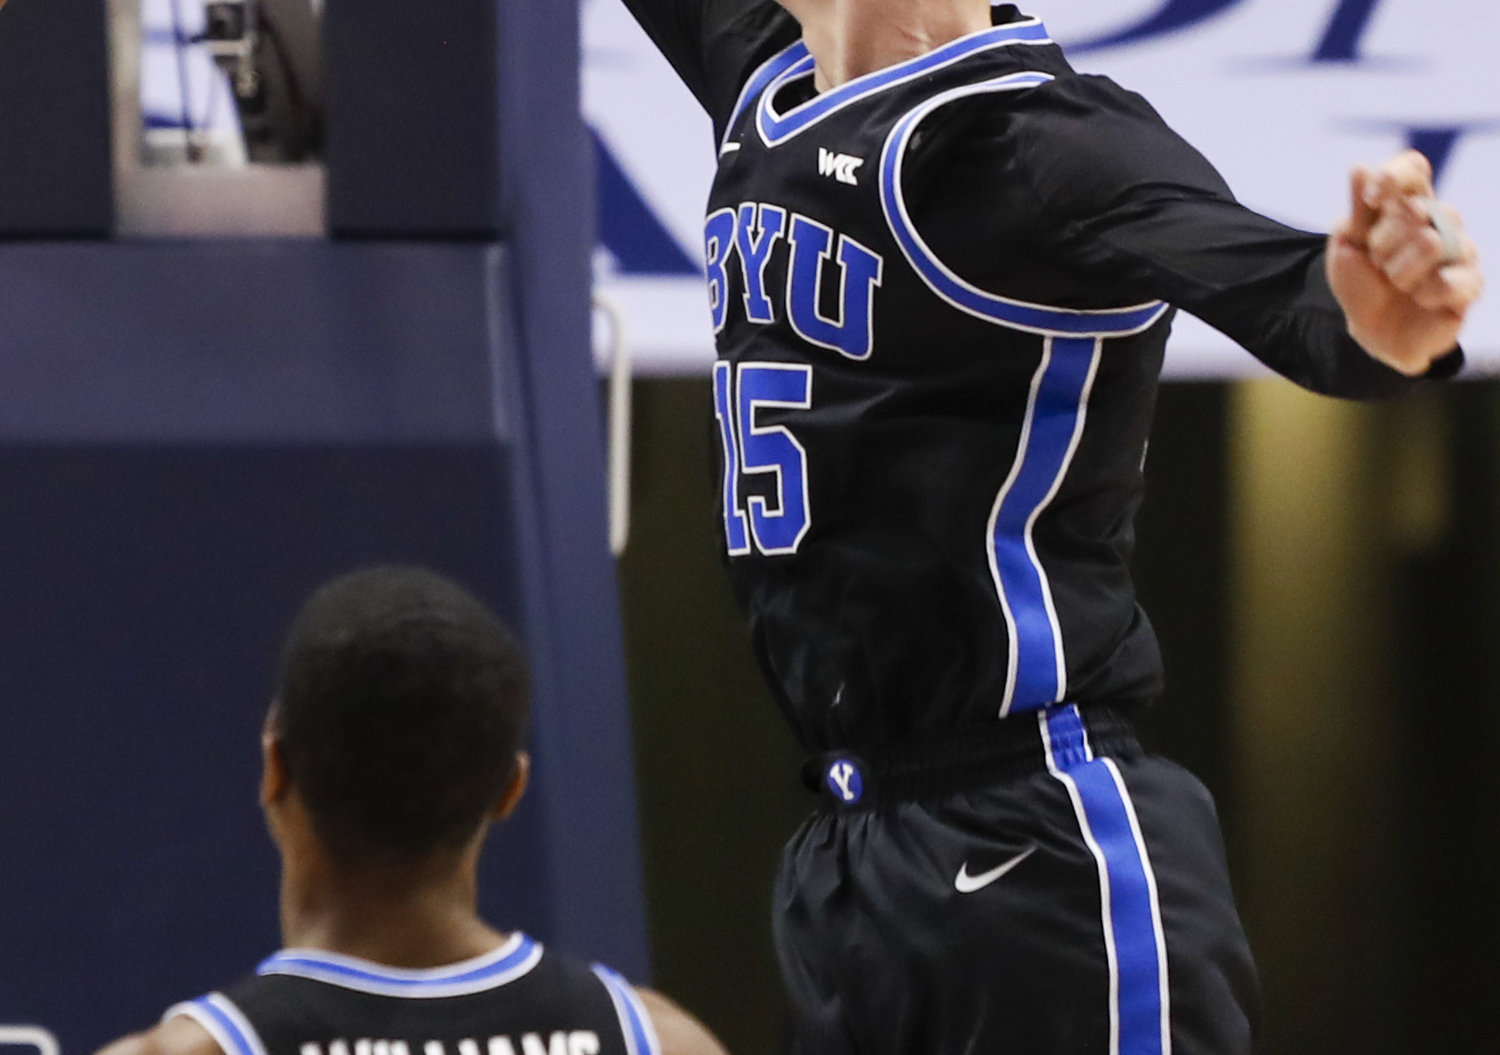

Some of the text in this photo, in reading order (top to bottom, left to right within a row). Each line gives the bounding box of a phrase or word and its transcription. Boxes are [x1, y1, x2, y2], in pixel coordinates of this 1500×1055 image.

[705, 201, 883, 361] BYU
[712, 360, 812, 556] 15
[828, 762, 855, 801] Y
